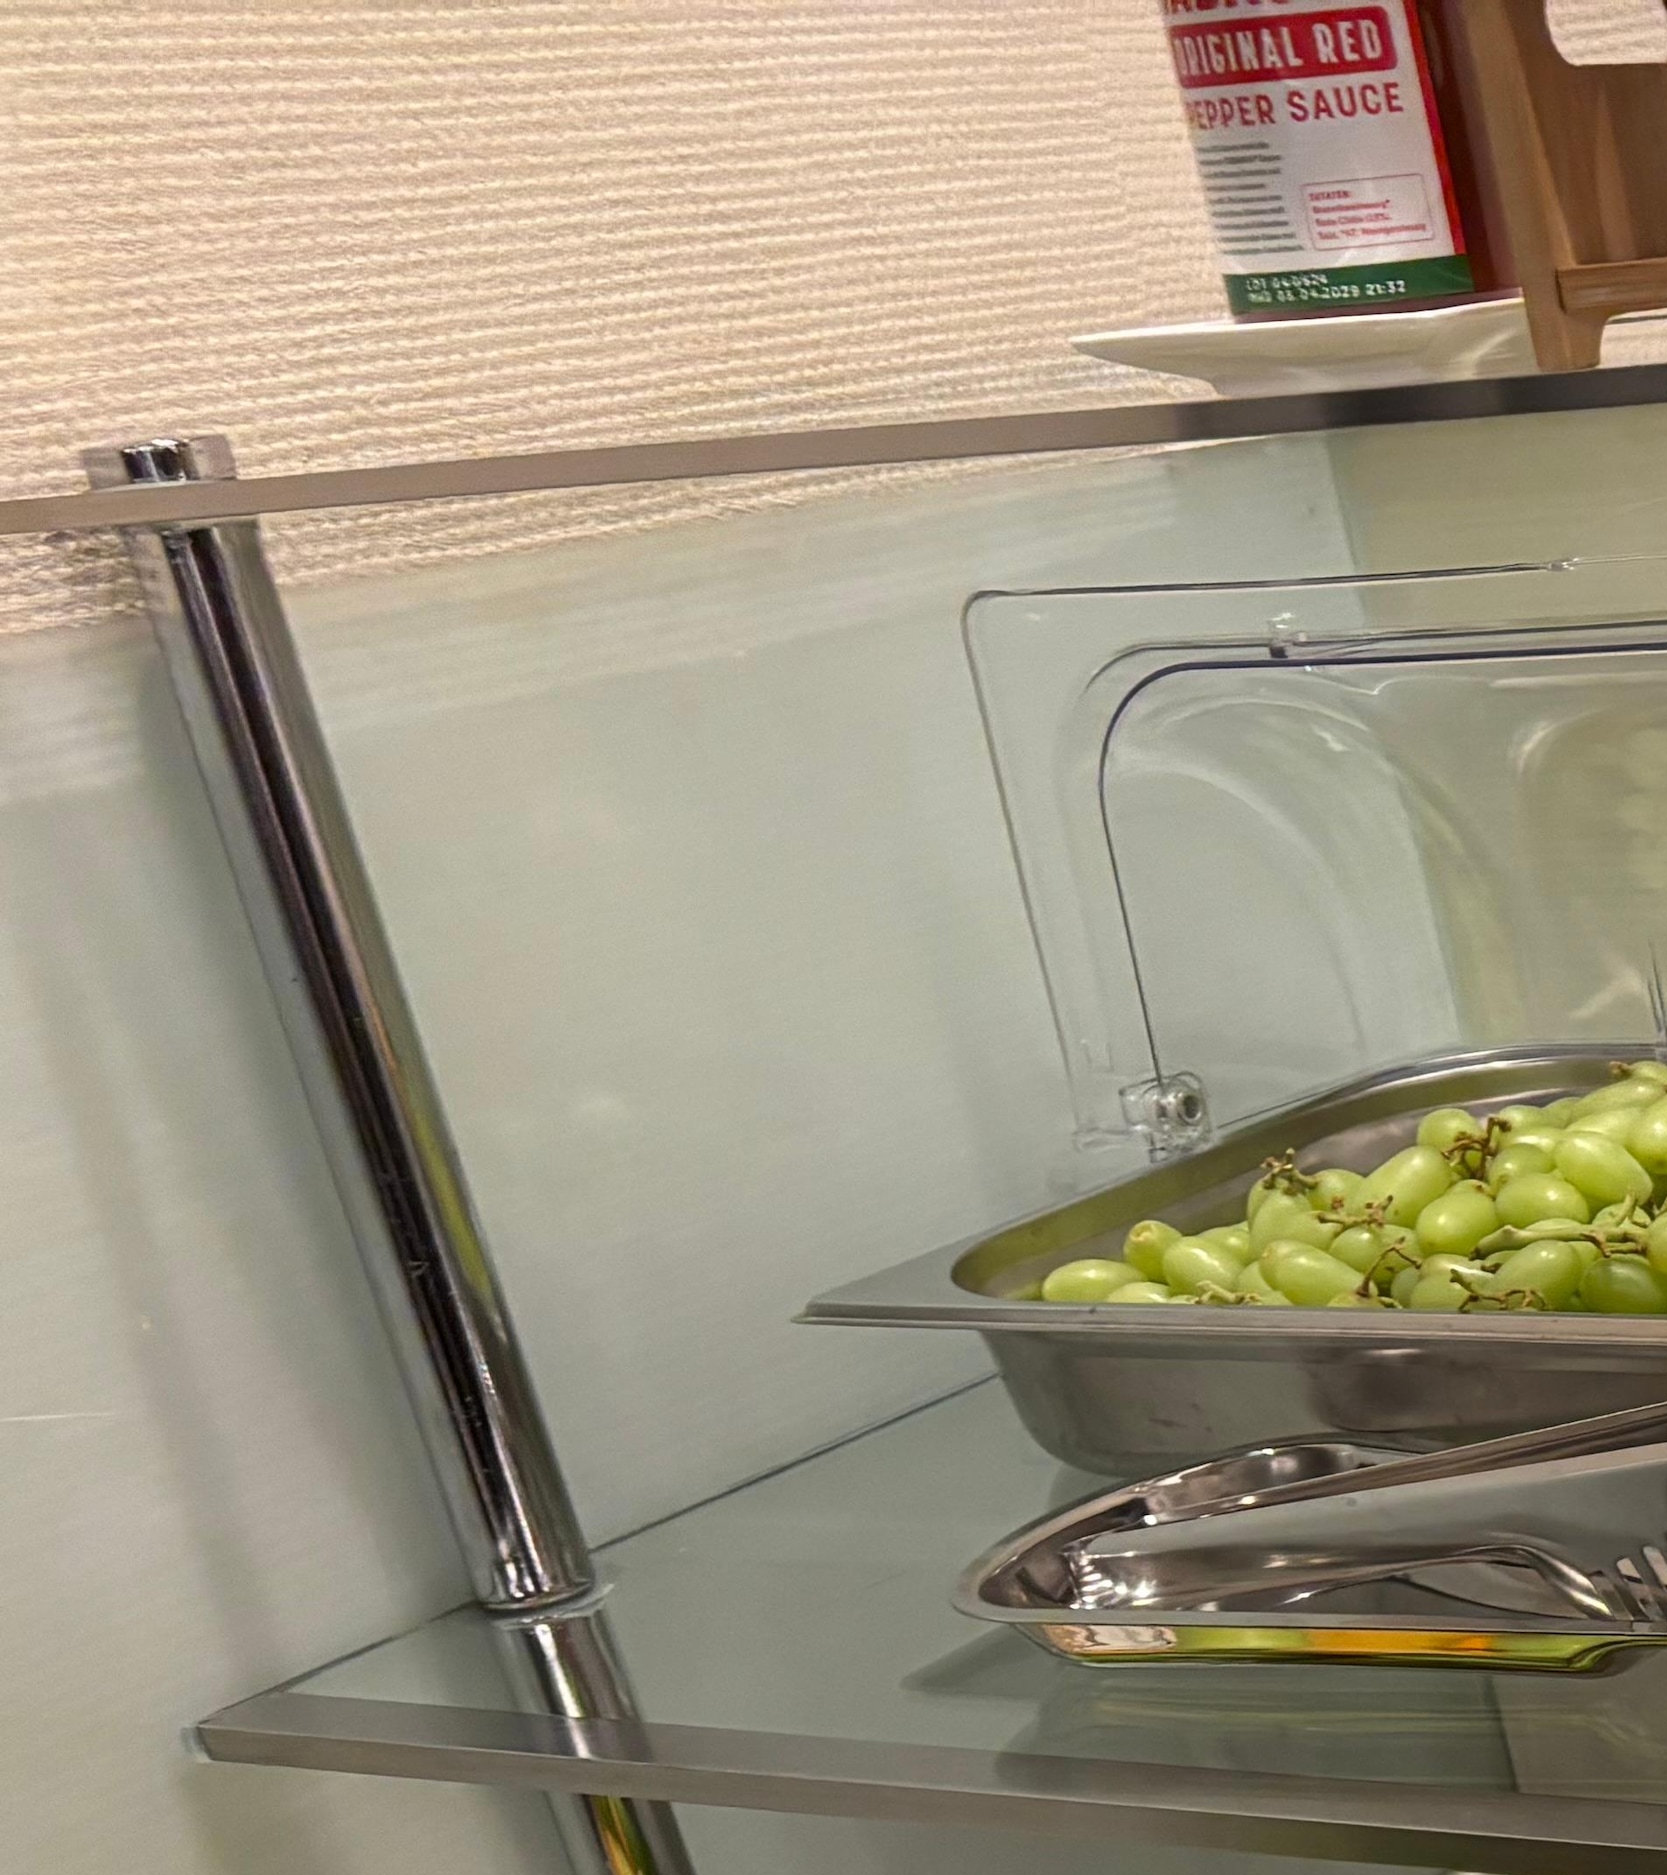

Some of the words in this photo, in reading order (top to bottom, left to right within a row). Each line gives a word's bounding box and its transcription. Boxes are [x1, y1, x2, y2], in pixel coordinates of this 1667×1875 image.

[1173, 26, 1304, 77] ORIGINAL
[1311, 19, 1384, 64] RED
[1286, 82, 1404, 123] SAUCE
